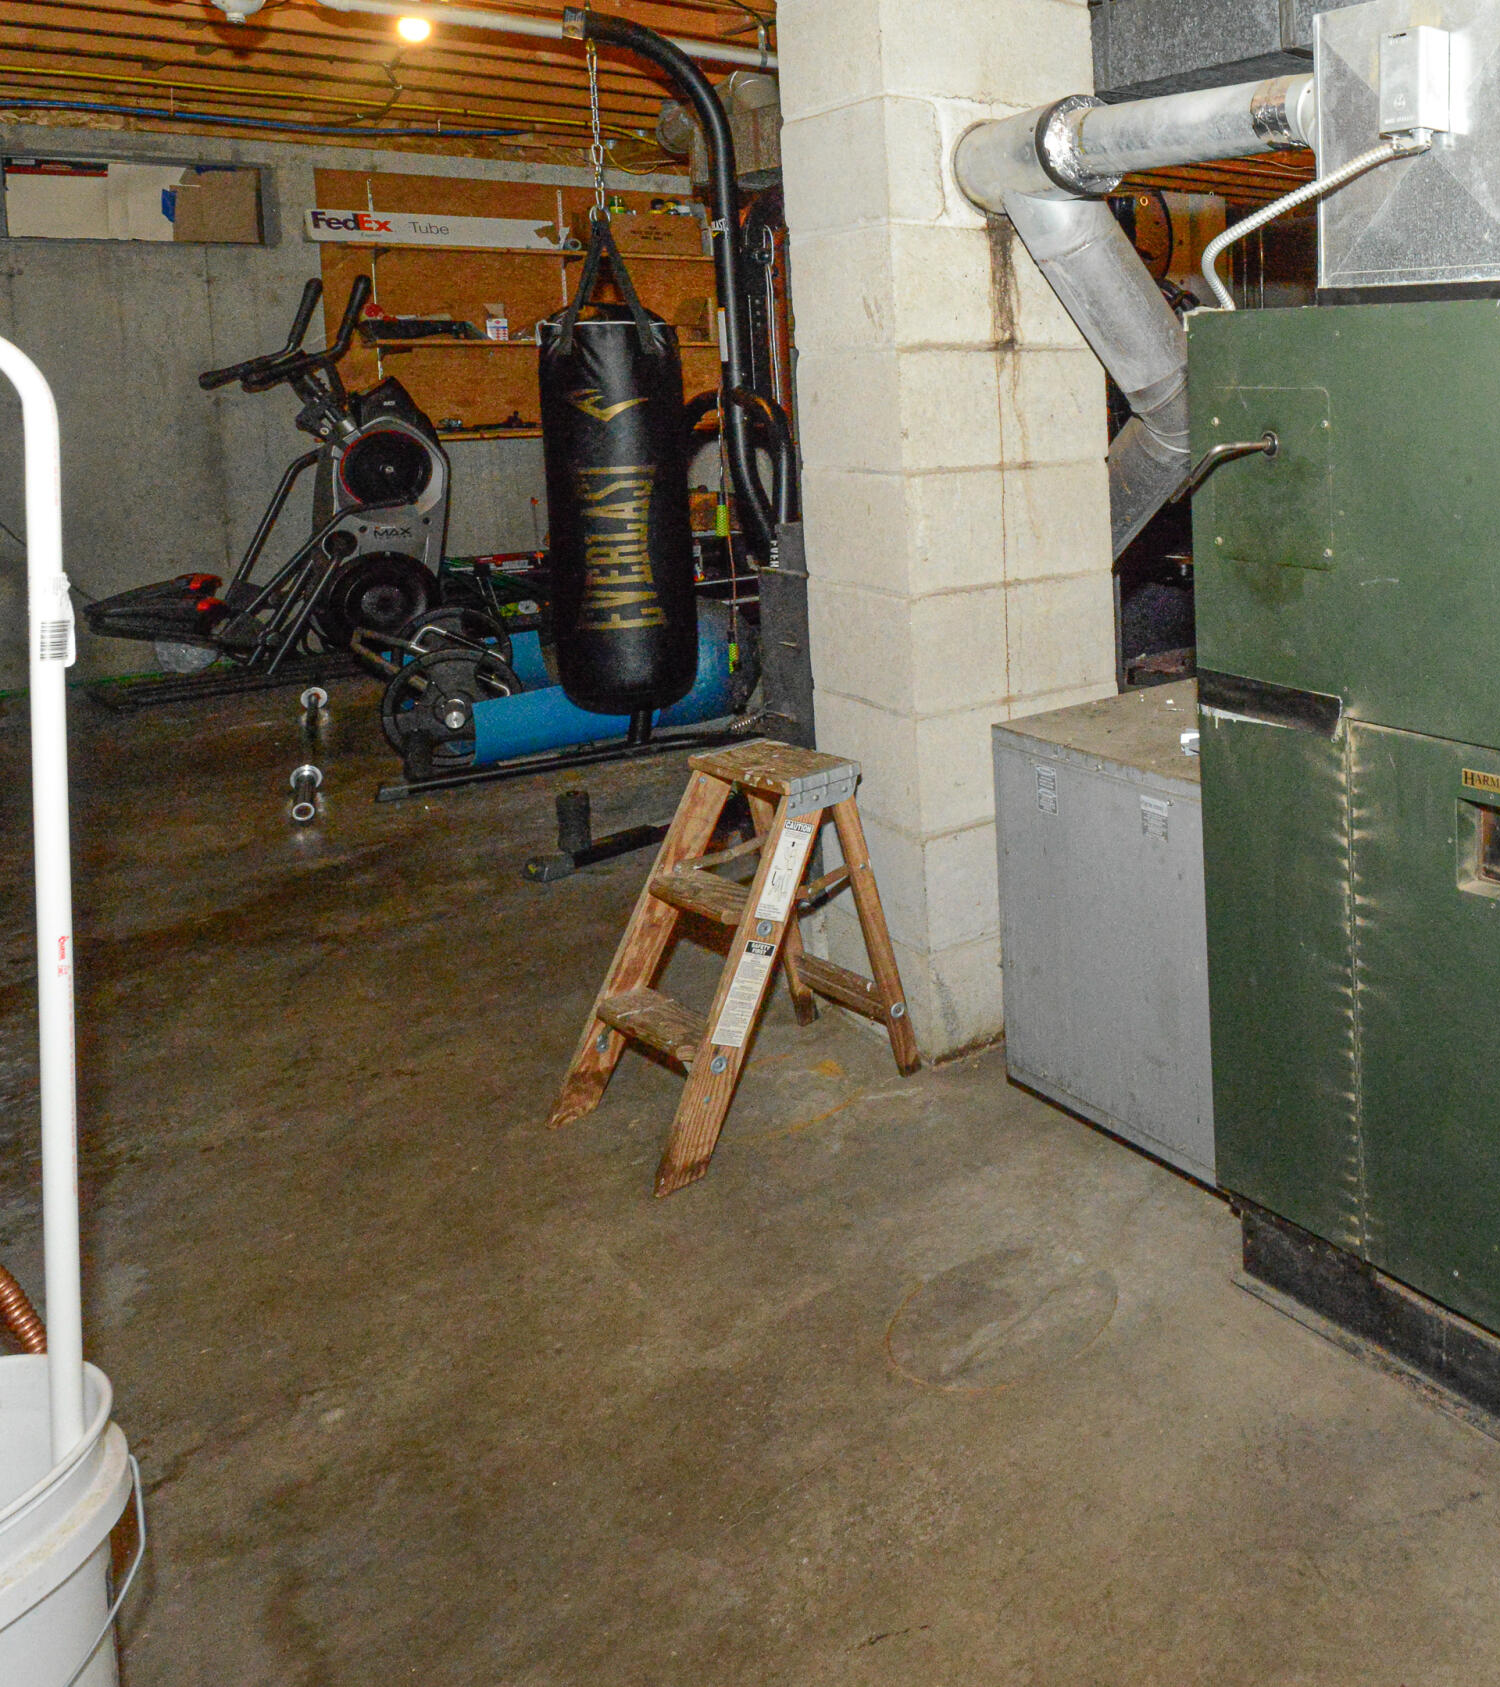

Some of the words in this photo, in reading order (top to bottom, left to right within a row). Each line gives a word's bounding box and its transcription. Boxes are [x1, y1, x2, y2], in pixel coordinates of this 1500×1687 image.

[310, 211, 393, 232] FedEx
[408, 221, 450, 235] Tube
[374, 527, 412, 538] MAX
[577, 465, 667, 630] EVERLAST
[785, 820, 813, 833] CAUTION
[752, 942, 771, 951] SAFETY
